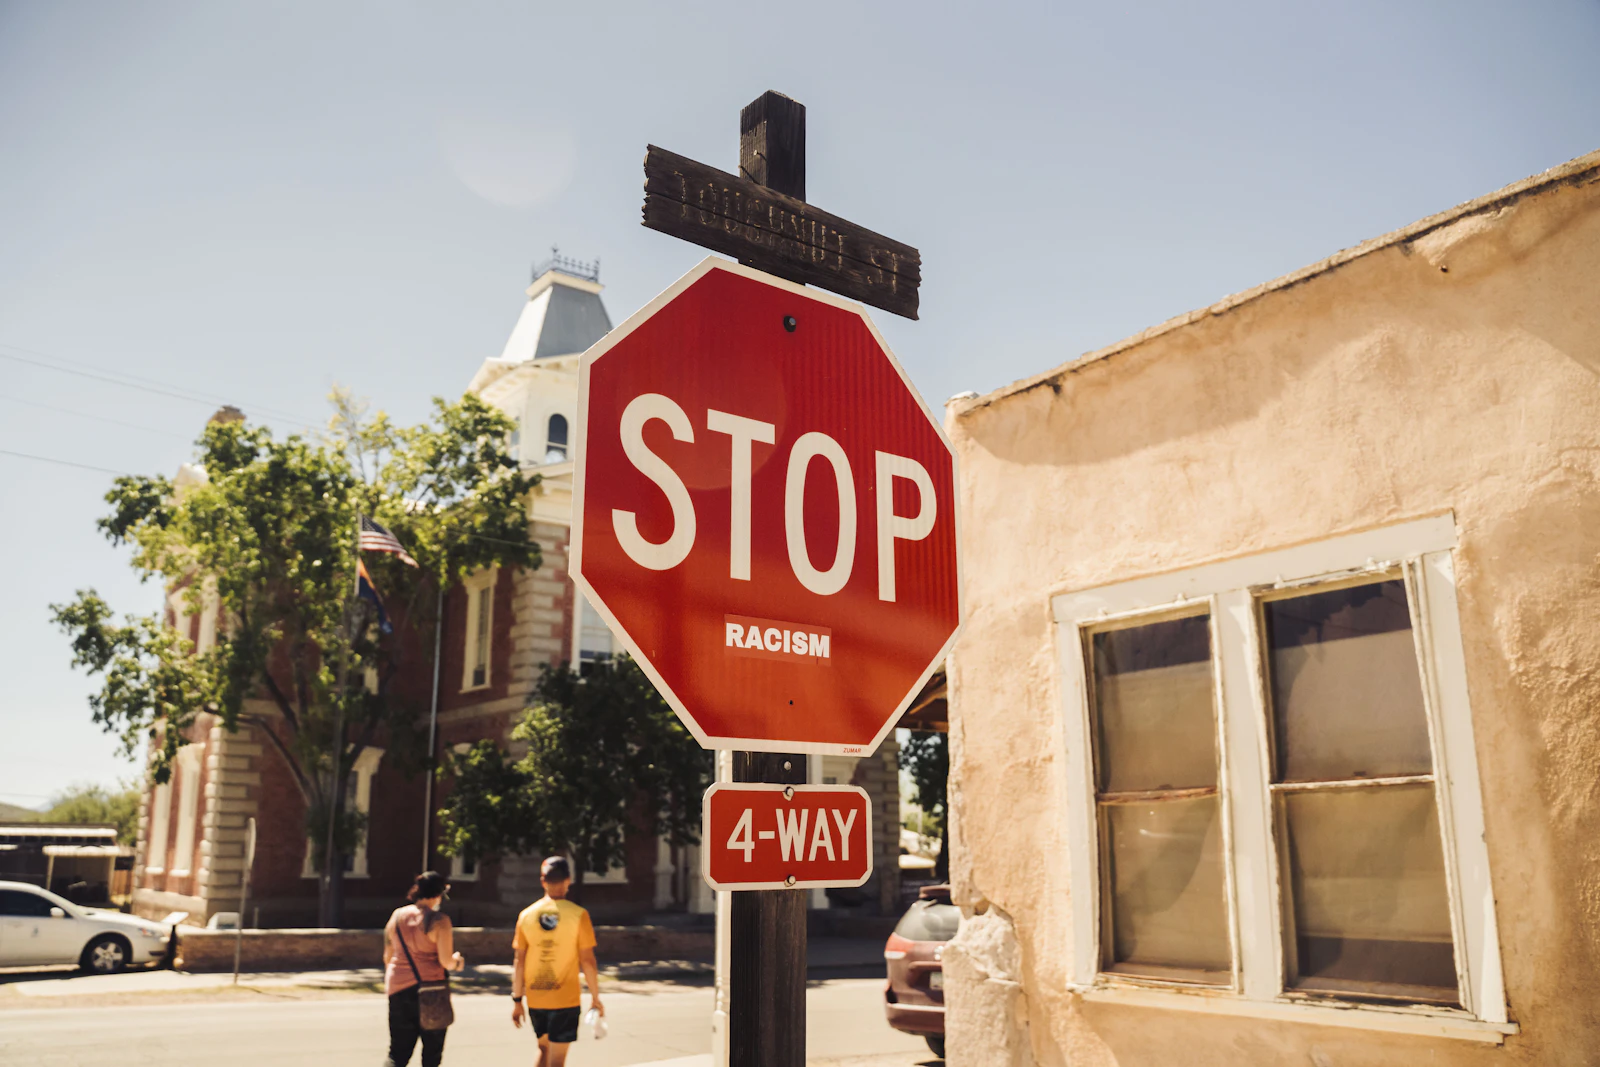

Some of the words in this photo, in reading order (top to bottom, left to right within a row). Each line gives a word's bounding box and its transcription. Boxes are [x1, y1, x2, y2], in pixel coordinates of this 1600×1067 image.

[673, 169, 848, 272] TOUGHNUT
[867, 248, 899, 294] ST
[612, 394, 937, 602] STOP
[725, 622, 830, 658] RACISM
[726, 808, 858, 863] 4-WAY
